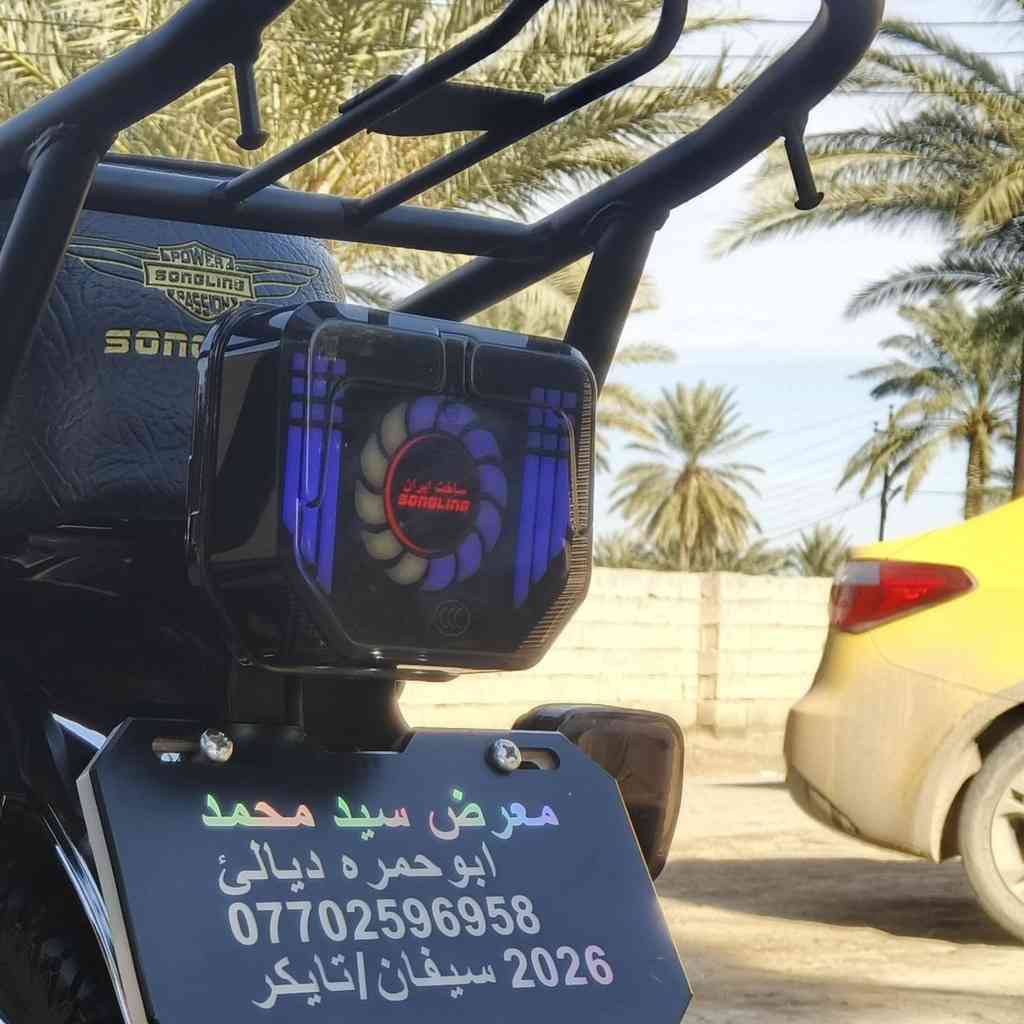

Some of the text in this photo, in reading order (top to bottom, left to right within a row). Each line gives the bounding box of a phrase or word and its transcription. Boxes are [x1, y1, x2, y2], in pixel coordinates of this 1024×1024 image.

[201, 789, 560, 841] معرض سيد محمد
[227, 894, 542, 946] 07702596958
[502, 944, 615, 989] 2026
